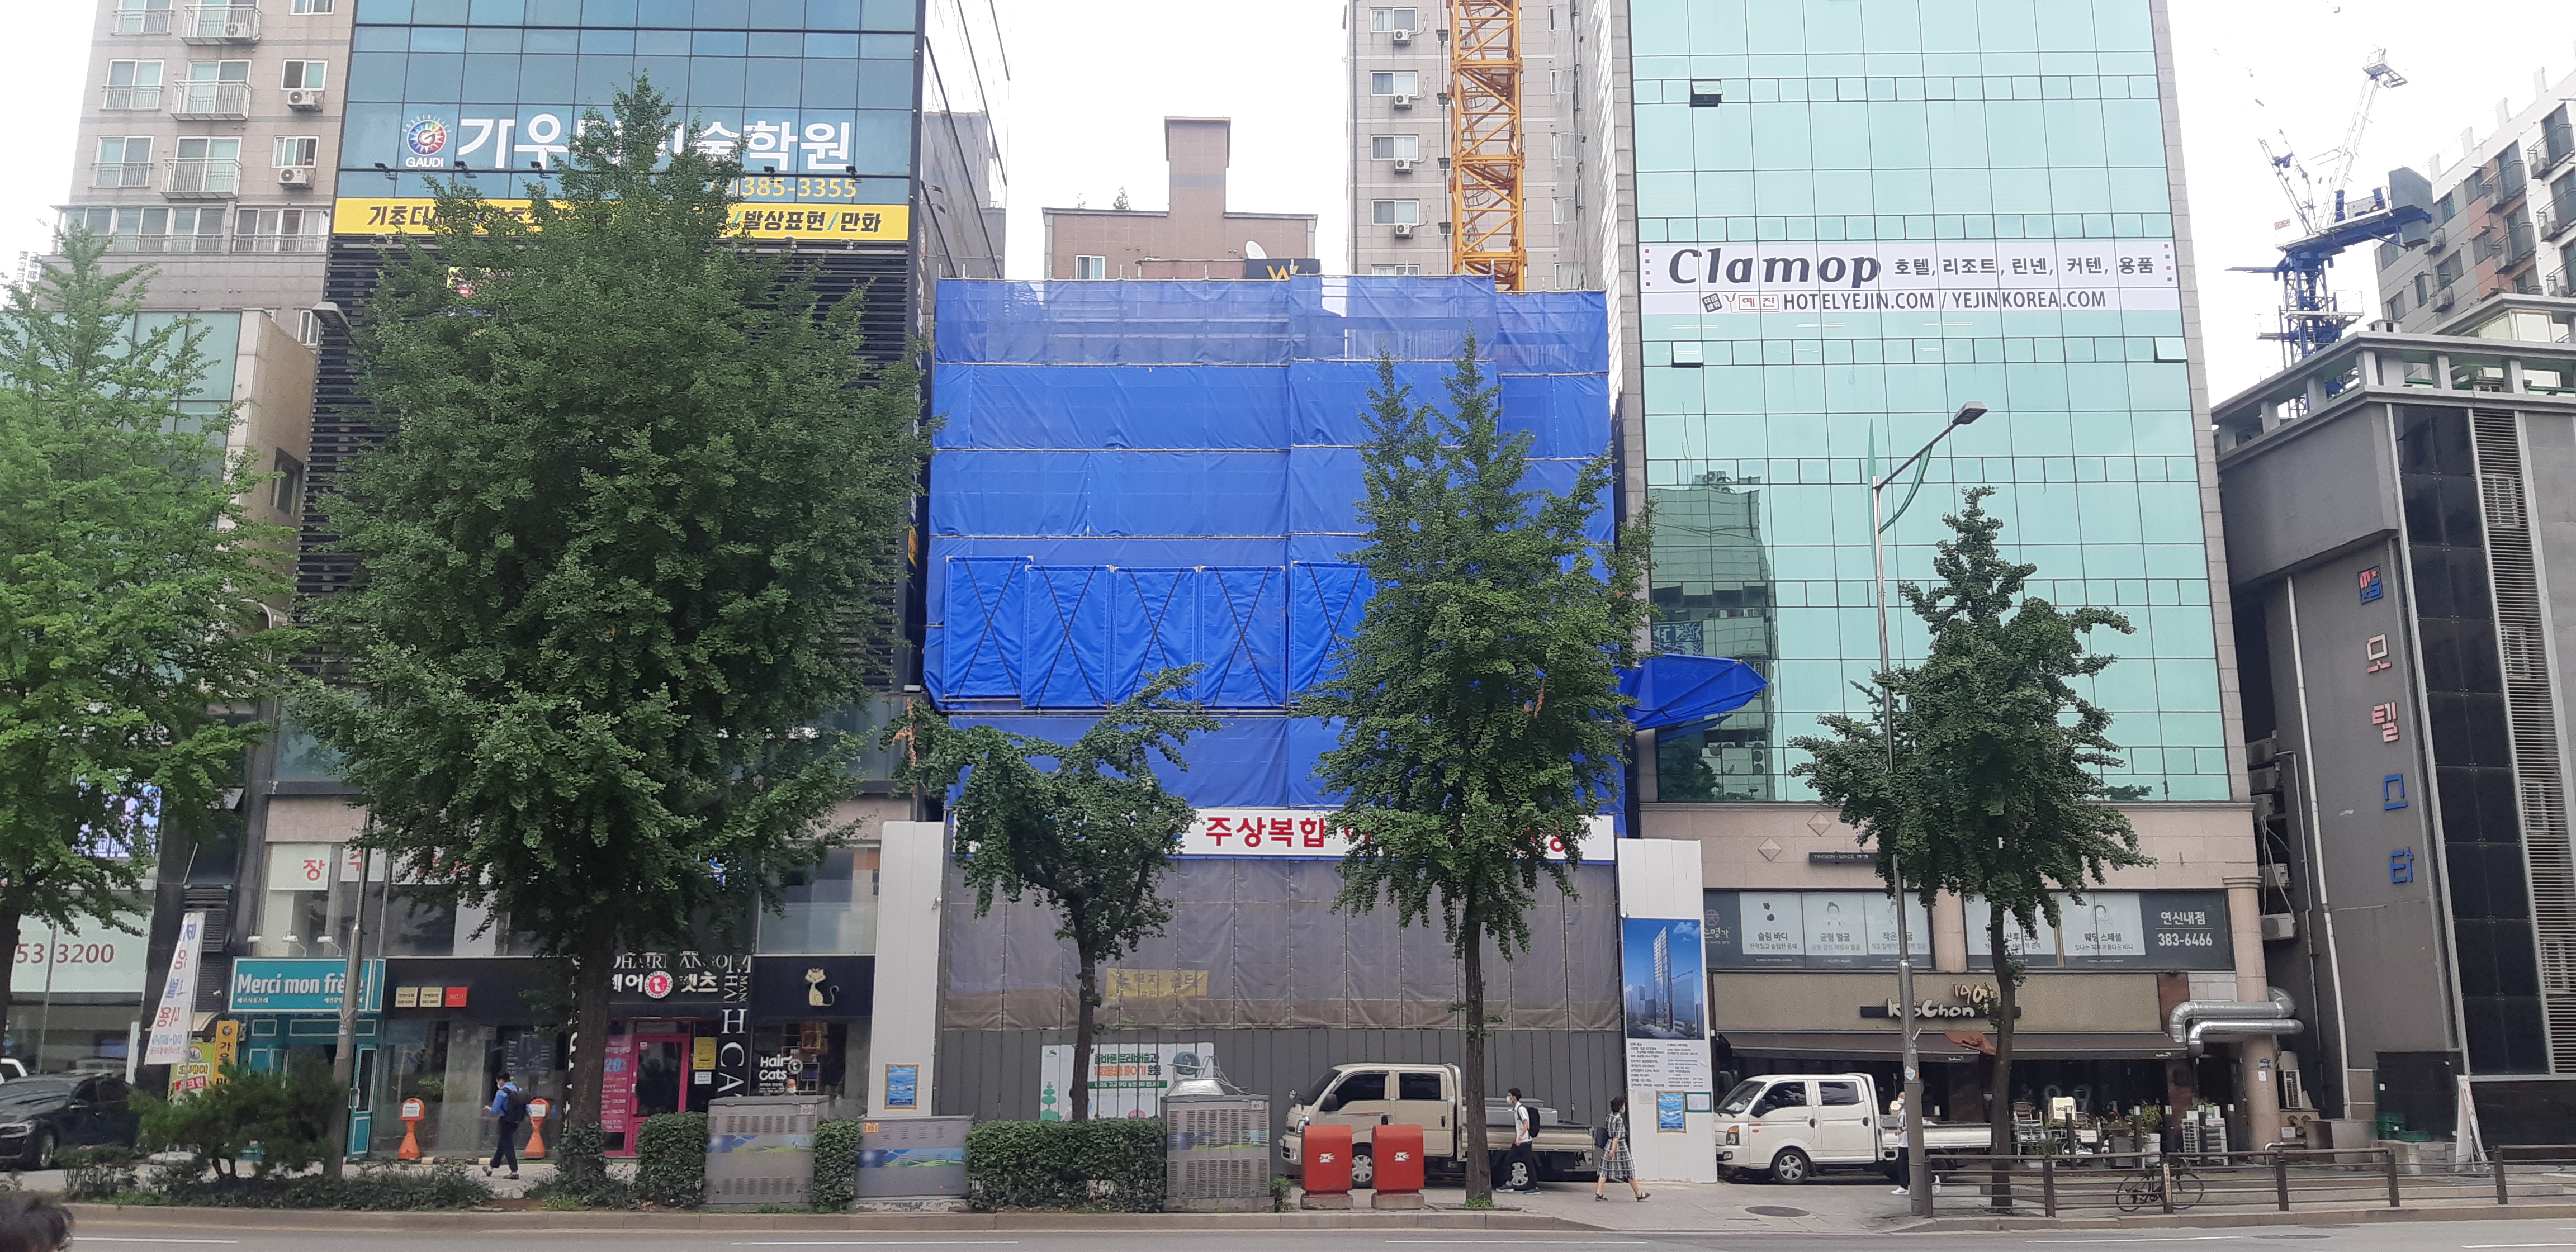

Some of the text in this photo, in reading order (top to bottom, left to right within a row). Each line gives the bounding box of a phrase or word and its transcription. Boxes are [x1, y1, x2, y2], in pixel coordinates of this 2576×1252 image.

[405, 157, 444, 168] GAUDI
[1669, 248, 1881, 288] Clamop
[2067, 257, 2109, 276] 커텐,
[2119, 257, 2154, 274] 용품
[1784, 293, 1934, 310] HOTELYEJIN.COM
[1952, 291, 2106, 309] YEJINKOREA.COM
[1205, 817, 1327, 848] 주상복합
[2161, 911, 2206, 926] 연신내점
[1774, 932, 1788, 941] 바디
[1820, 933, 1850, 942] 균형 얼굴
[1883, 932, 1897, 941] 작은
[2084, 933, 2122, 942] 웨딩 스페셜
[2157, 932, 2213, 947] 383-6466
[55, 943, 115, 964] 3200
[237, 973, 364, 994] Merci mon frè
[760, 1054, 793, 1068] Hair
[759, 1070, 787, 1080] Cats
